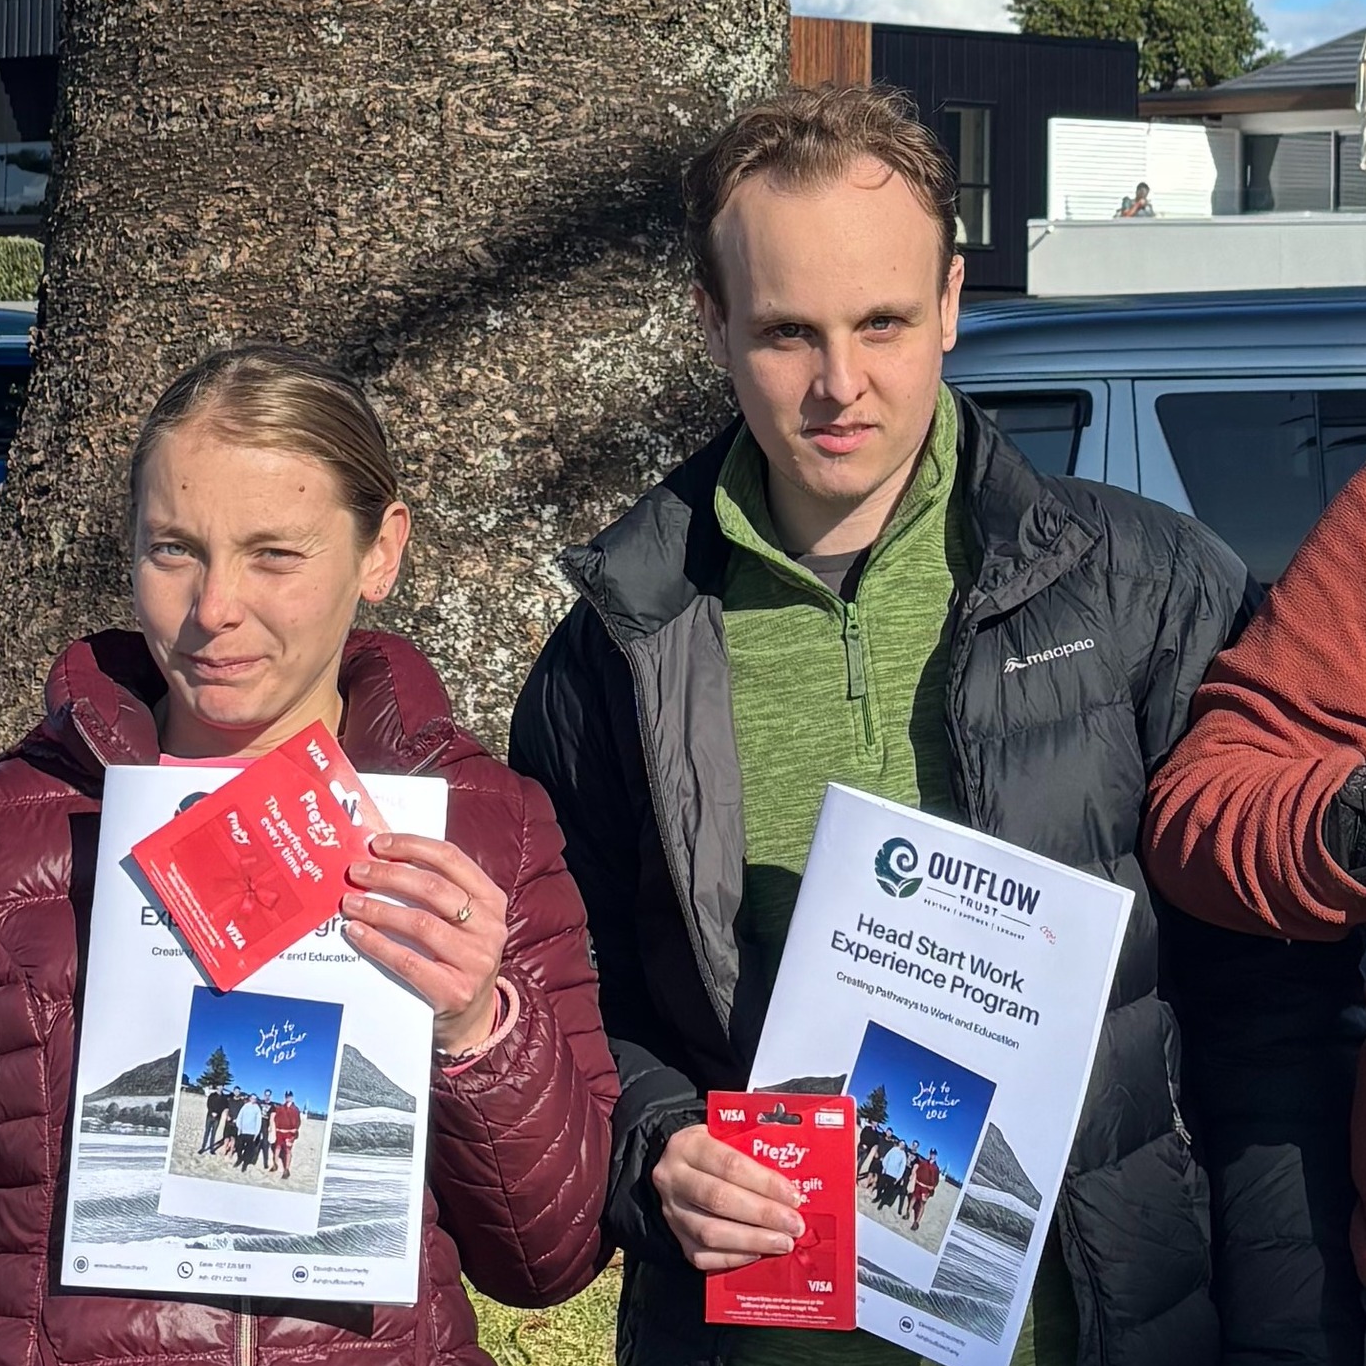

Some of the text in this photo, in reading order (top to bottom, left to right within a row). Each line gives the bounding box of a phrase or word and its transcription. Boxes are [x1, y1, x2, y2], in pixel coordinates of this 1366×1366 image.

[306, 738, 331, 772] VISA
[299, 789, 338, 849] Prezzy
[260, 816, 302, 879] every time.
[264, 795, 324, 883] The perfect gift
[927, 851, 1042, 916] OUTFLOW
[959, 895, 999, 918] TRUST
[225, 920, 247, 951] VISA
[286, 951, 306, 962] and
[308, 951, 361, 963] Education
[856, 913, 1026, 994] Head Start Work
[830, 929, 1041, 1027] Experience Program
[836, 971, 1020, 1050] Creating Pathways to Work and Education
[283, 1019, 295, 1033] to
[255, 1031, 307, 1058] September
[940, 1081, 951, 1094] to
[718, 1108, 746, 1123] VISA
[912, 1094, 961, 1112] September
[752, 1138, 806, 1163] Prezzy
[802, 1177, 823, 1193] gift
[807, 1279, 833, 1293] VISA
